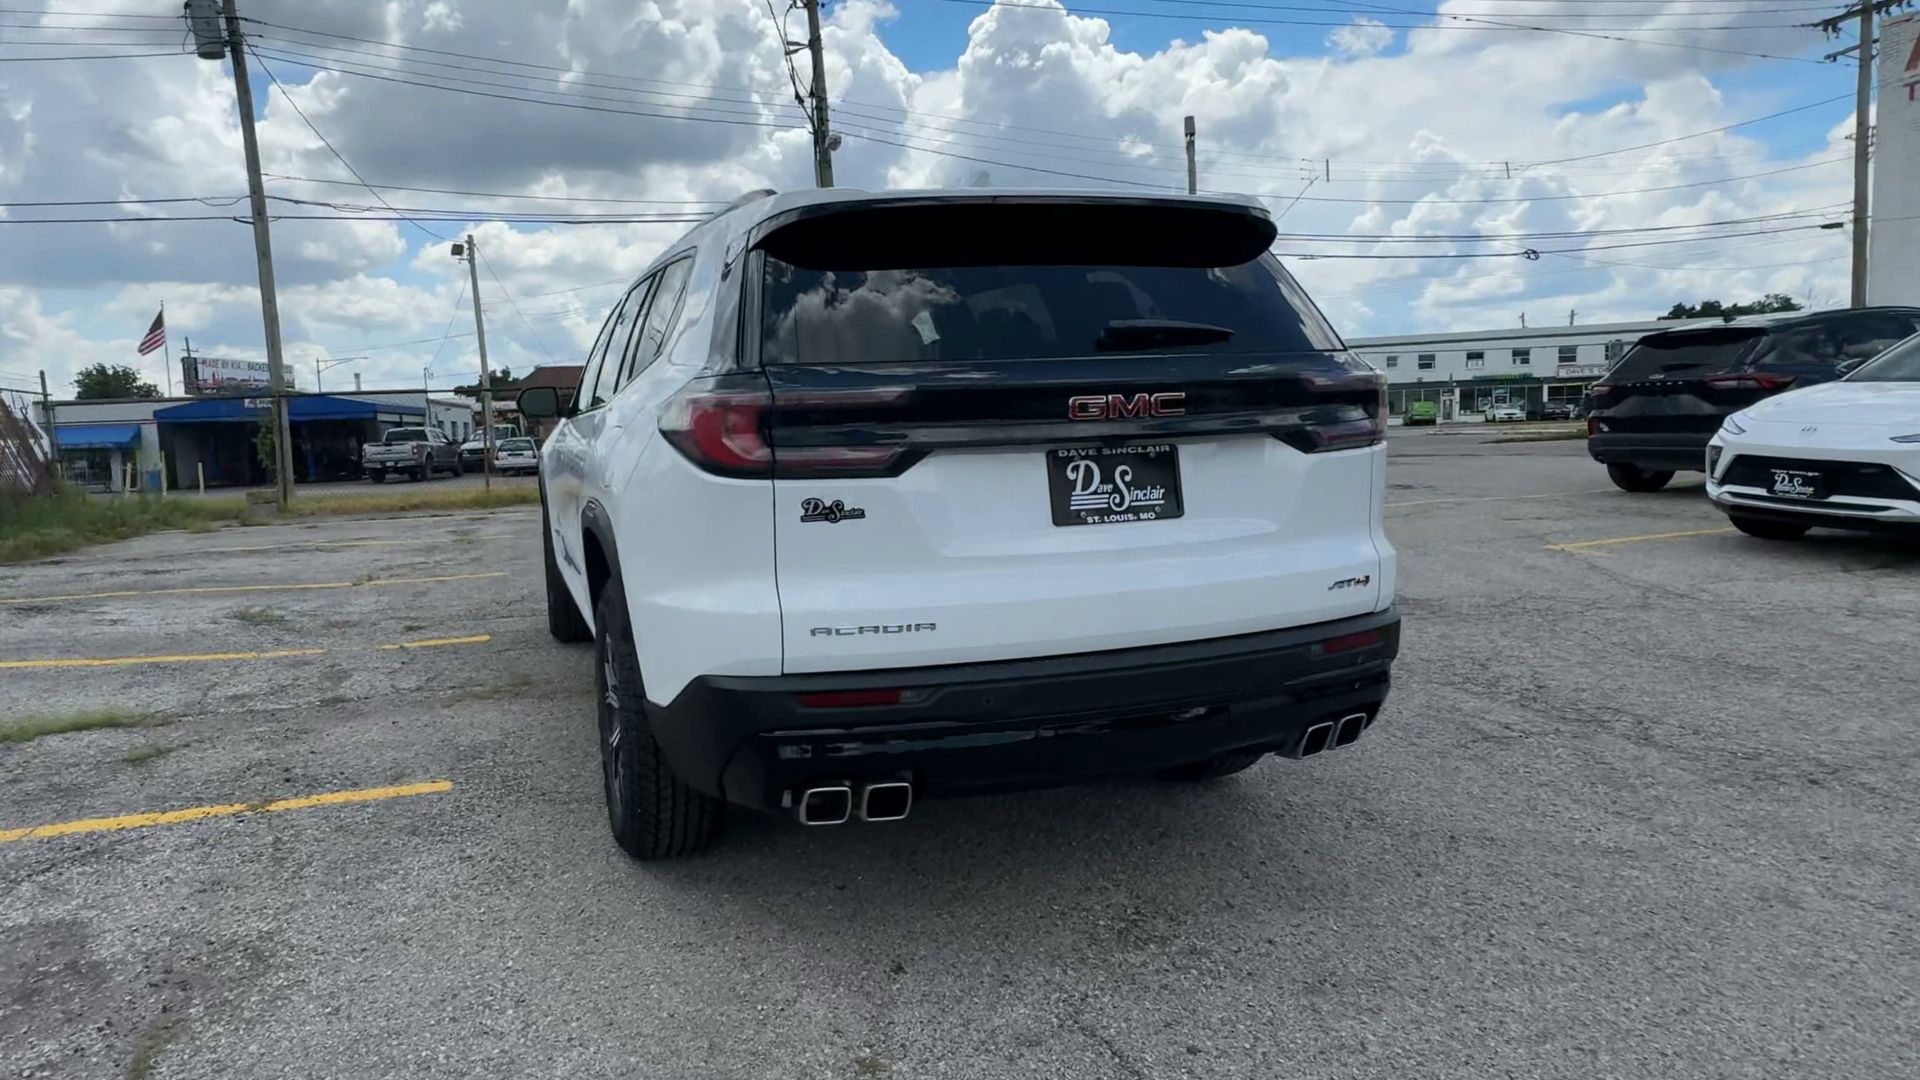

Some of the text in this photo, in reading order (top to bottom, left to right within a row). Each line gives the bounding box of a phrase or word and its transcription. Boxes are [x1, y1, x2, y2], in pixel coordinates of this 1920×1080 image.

[1068, 392, 1186, 420] GMC
[1058, 445, 1170, 457] DAVE SINCLAIR
[1066, 460, 1166, 511] Dave Sinclair
[1086, 516, 1102, 524] ST.
[1139, 511, 1156, 520] MO
[810, 622, 937, 637] ACADIA
